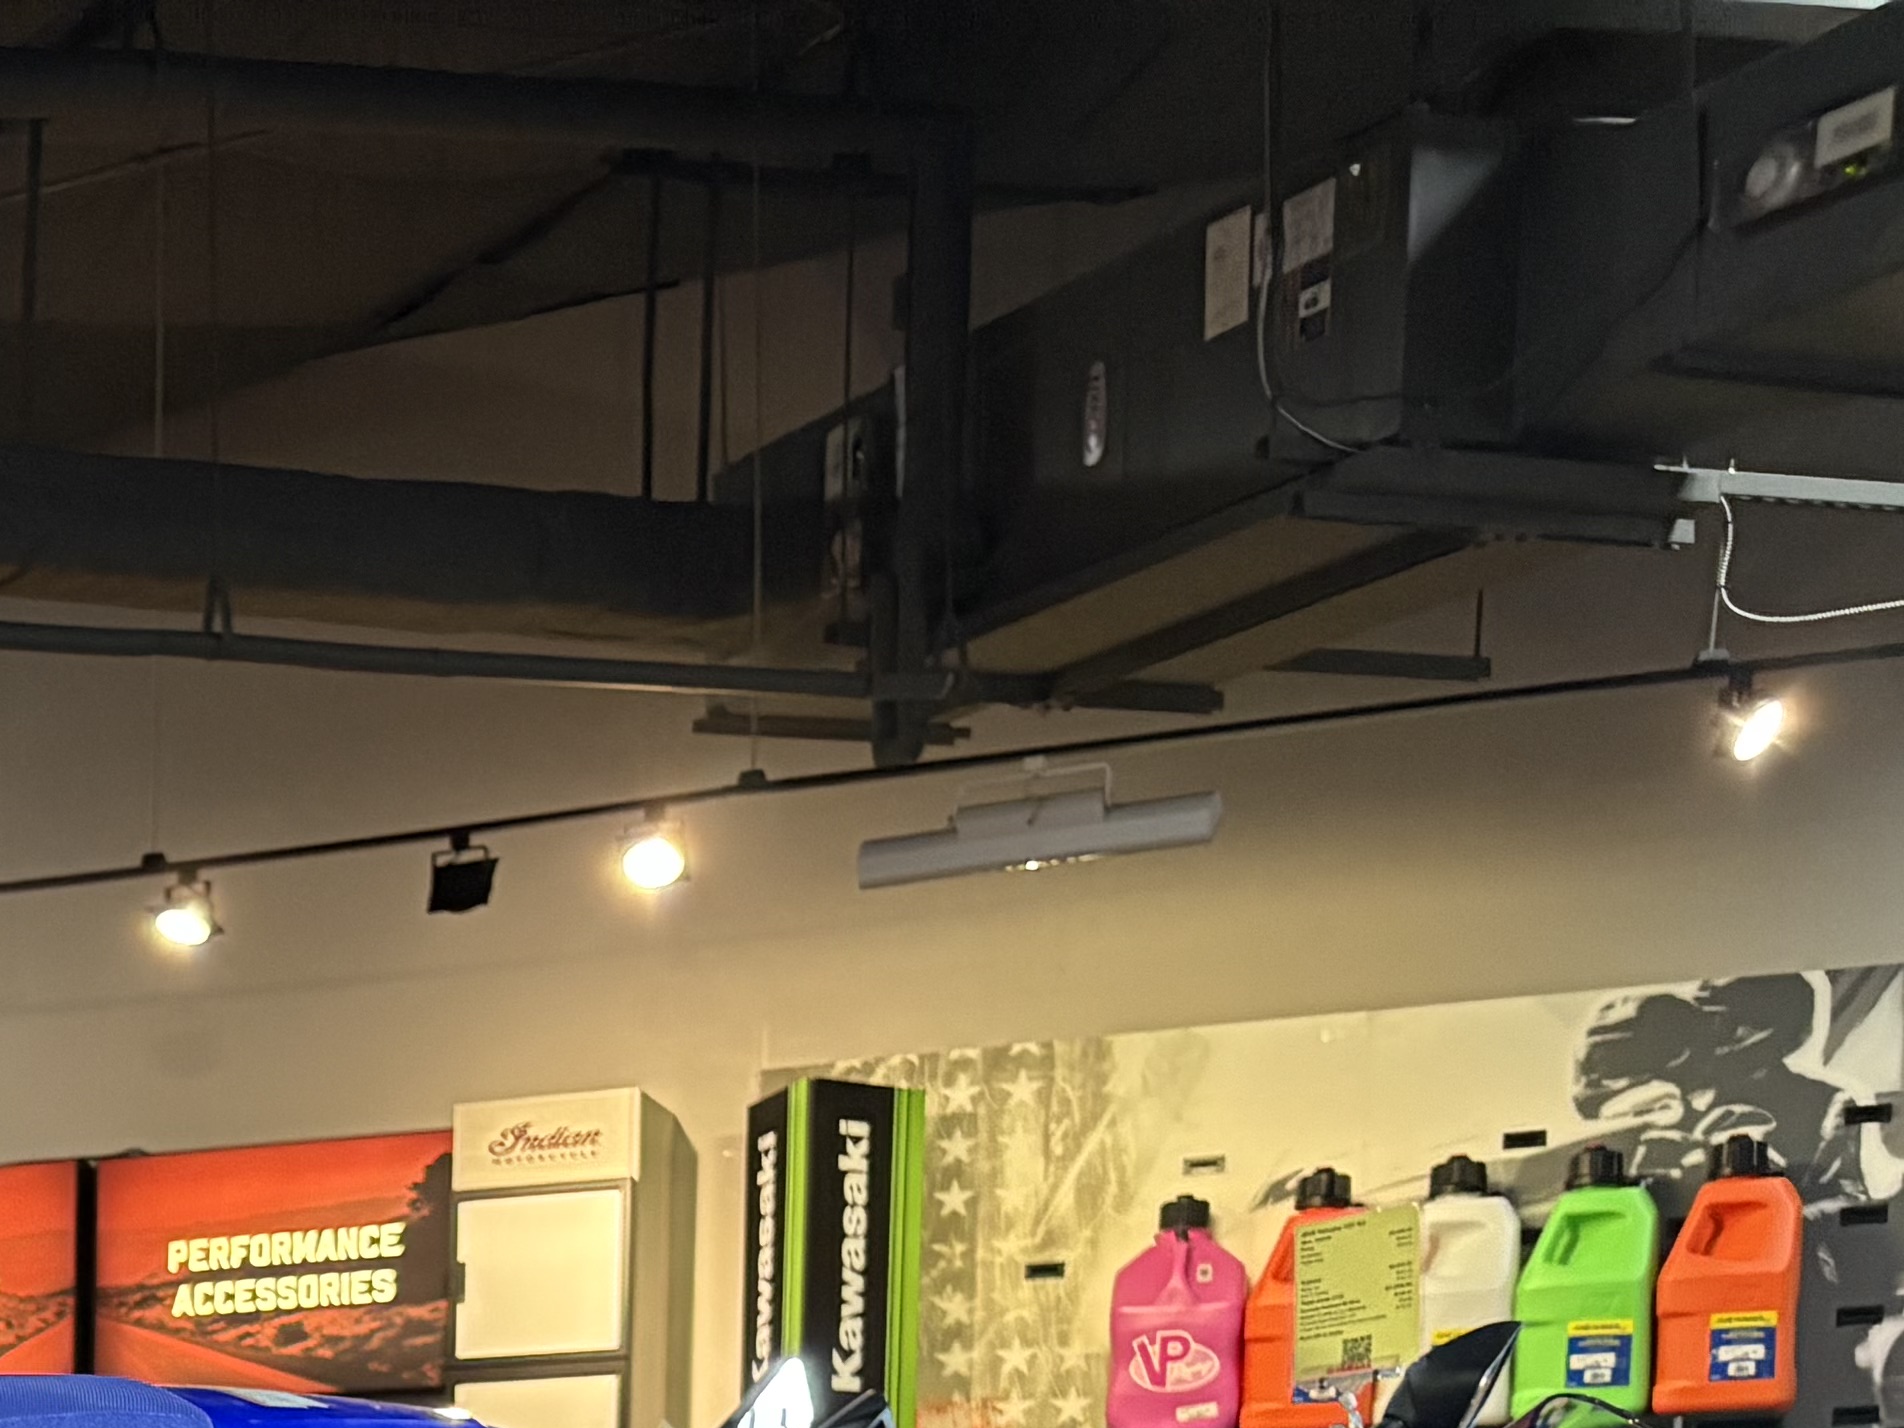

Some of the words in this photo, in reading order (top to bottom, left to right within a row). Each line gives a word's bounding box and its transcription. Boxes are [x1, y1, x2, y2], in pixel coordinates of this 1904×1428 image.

[488, 1120, 603, 1157] Indian
[166, 1221, 406, 1274] PERFORMANCE
[831, 1118, 872, 1393] Kawasaki
[171, 1269, 398, 1319] ACCESSORIES
